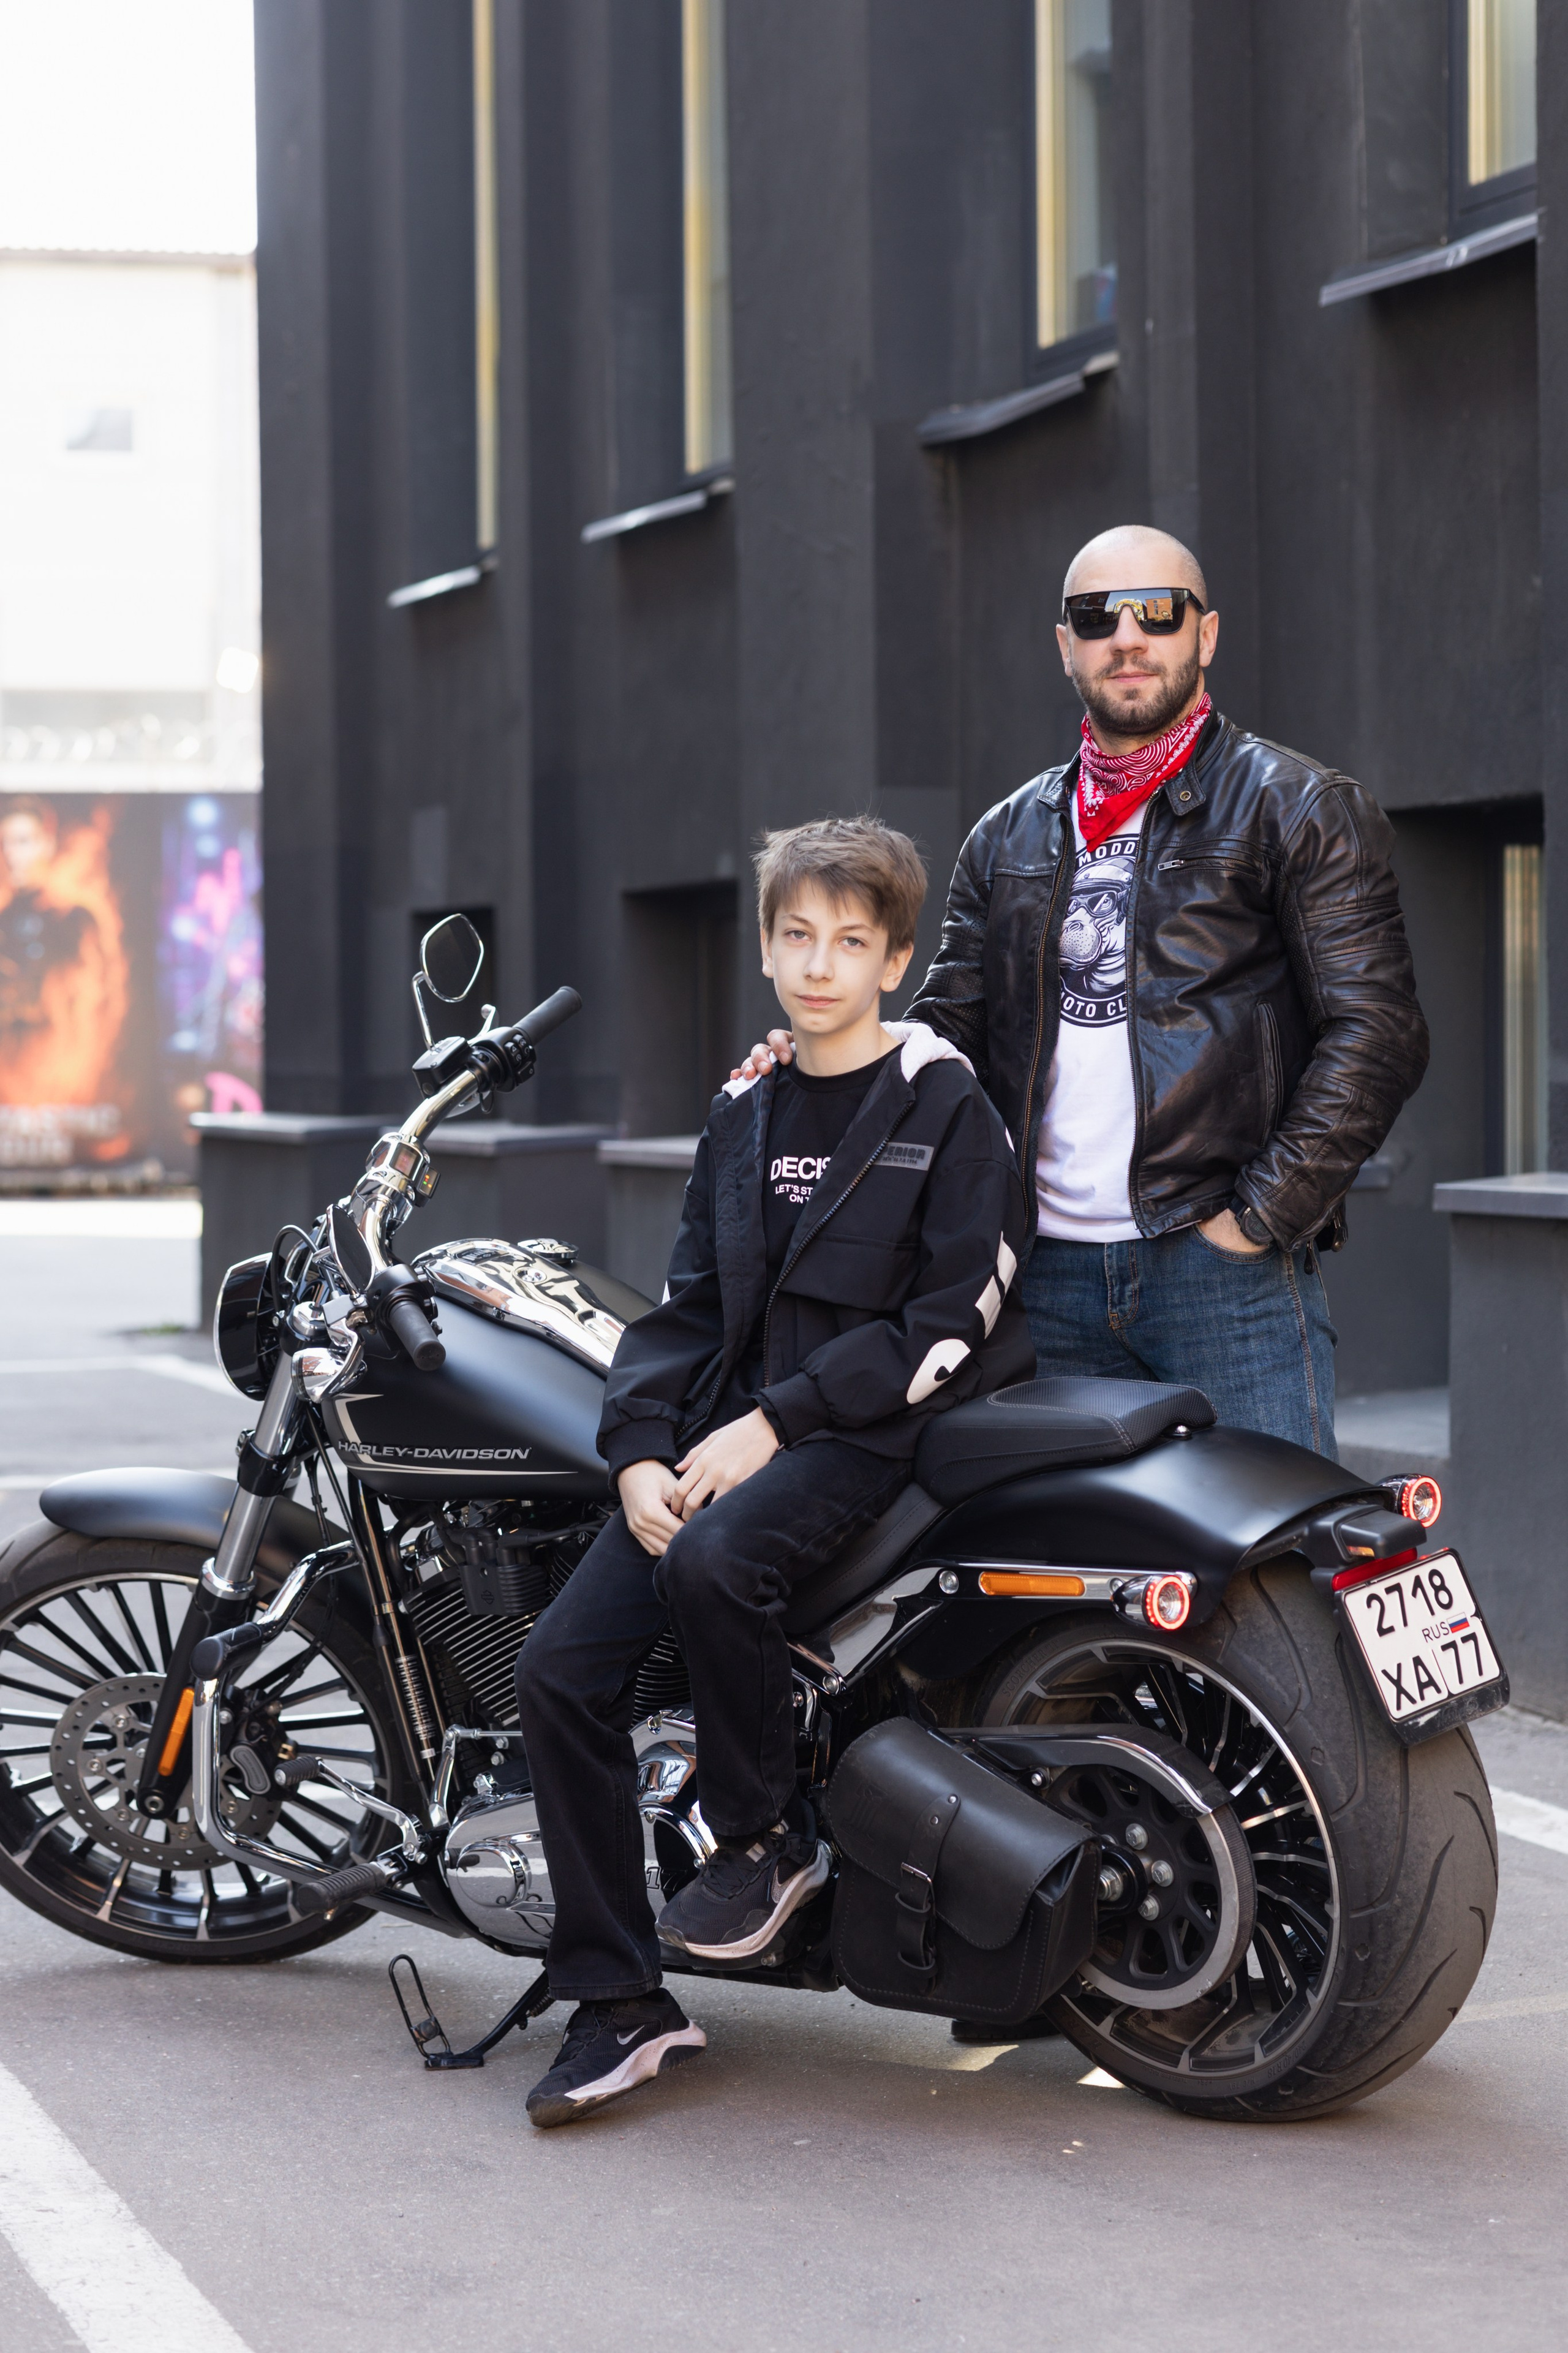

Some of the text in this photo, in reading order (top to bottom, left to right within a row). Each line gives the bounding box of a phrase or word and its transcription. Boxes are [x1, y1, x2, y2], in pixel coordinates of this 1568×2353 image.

[1079, 841, 1136, 868] MODD
[775, 1184, 813, 1196] LET'S ST
[789, 1193, 804, 1204] ON
[338, 1441, 530, 1460] HARLEY-DAVIDSON
[1366, 1568, 1453, 1638] 2718
[1422, 1621, 1450, 1644] RUS
[1440, 1631, 1483, 1685] 77
